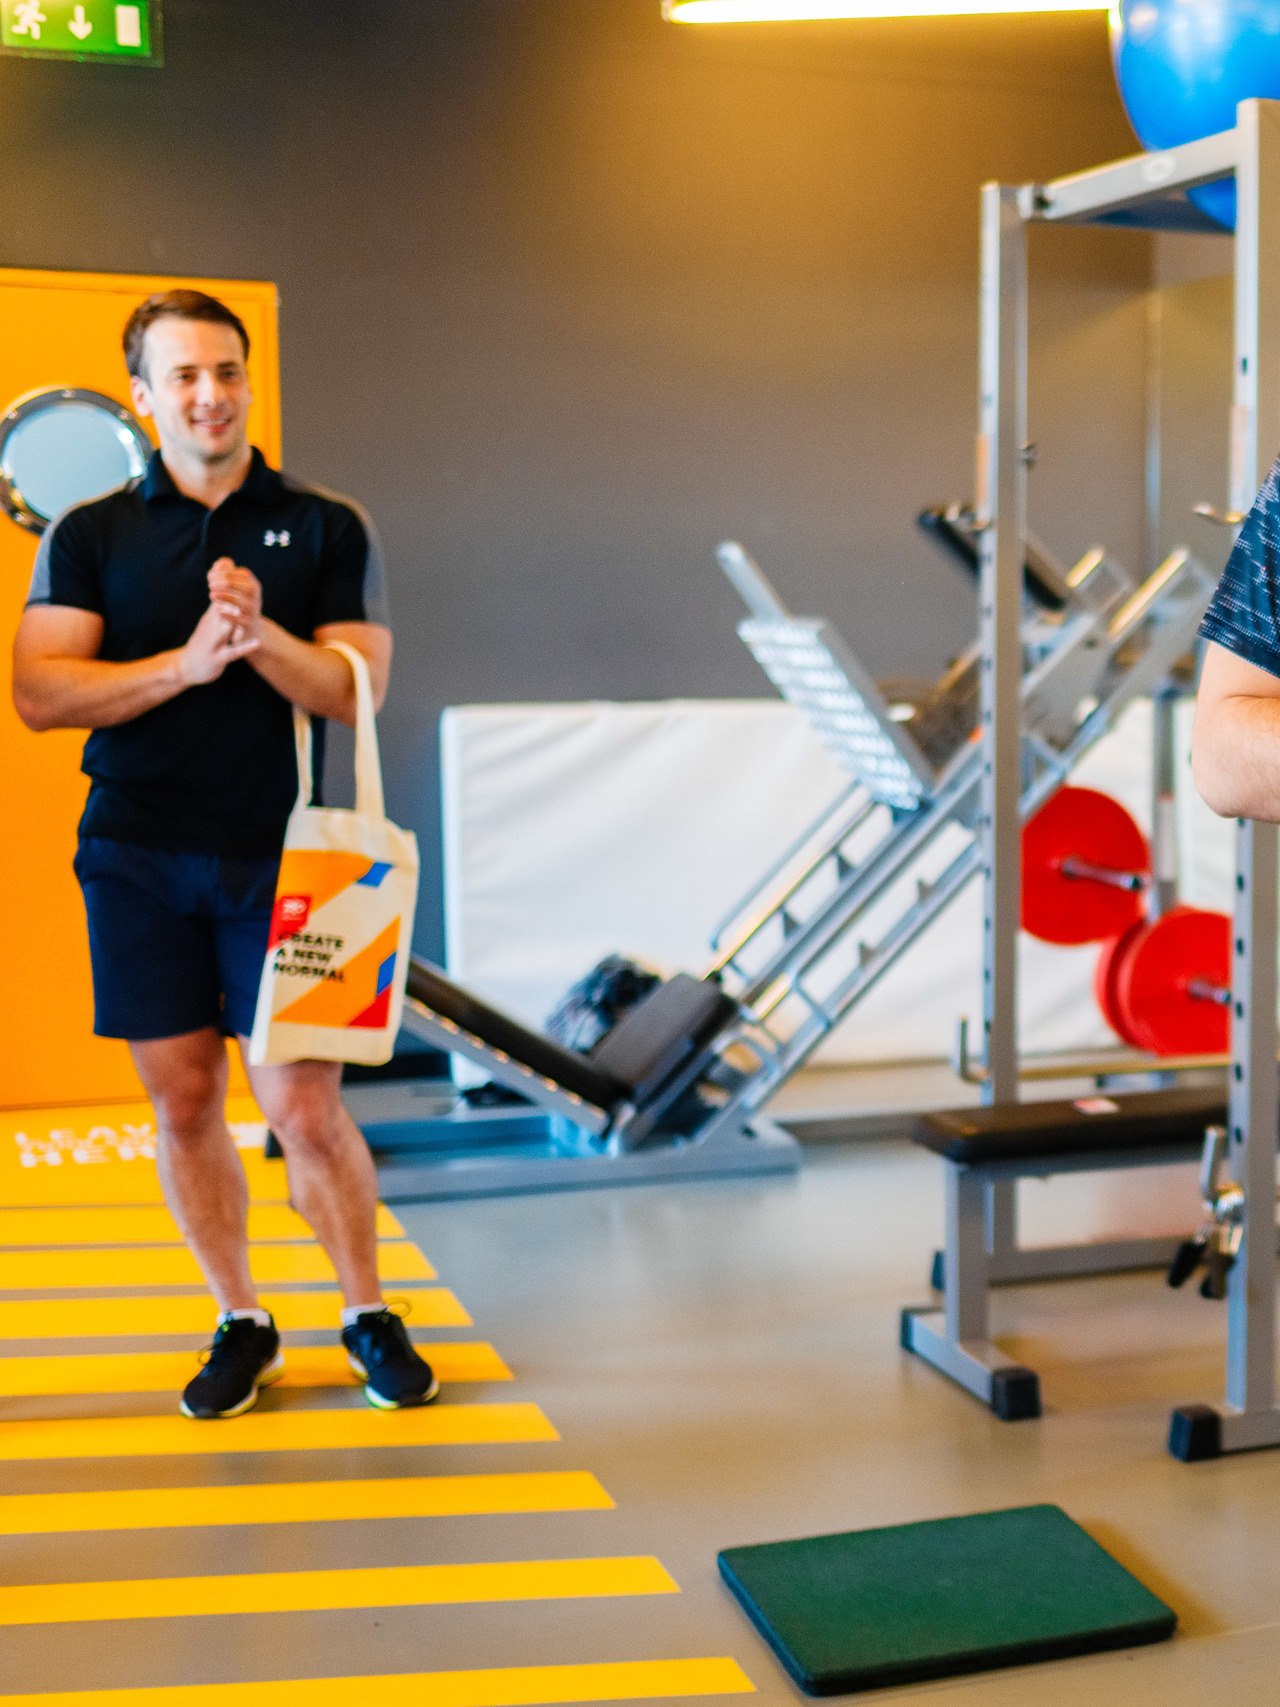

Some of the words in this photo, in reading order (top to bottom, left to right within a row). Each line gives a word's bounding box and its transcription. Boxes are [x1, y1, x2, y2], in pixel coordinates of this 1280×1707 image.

[278, 932, 344, 950] CREATE
[275, 947, 286, 957] A
[293, 949, 333, 963] NEW
[273, 962, 345, 983] NORMAL
